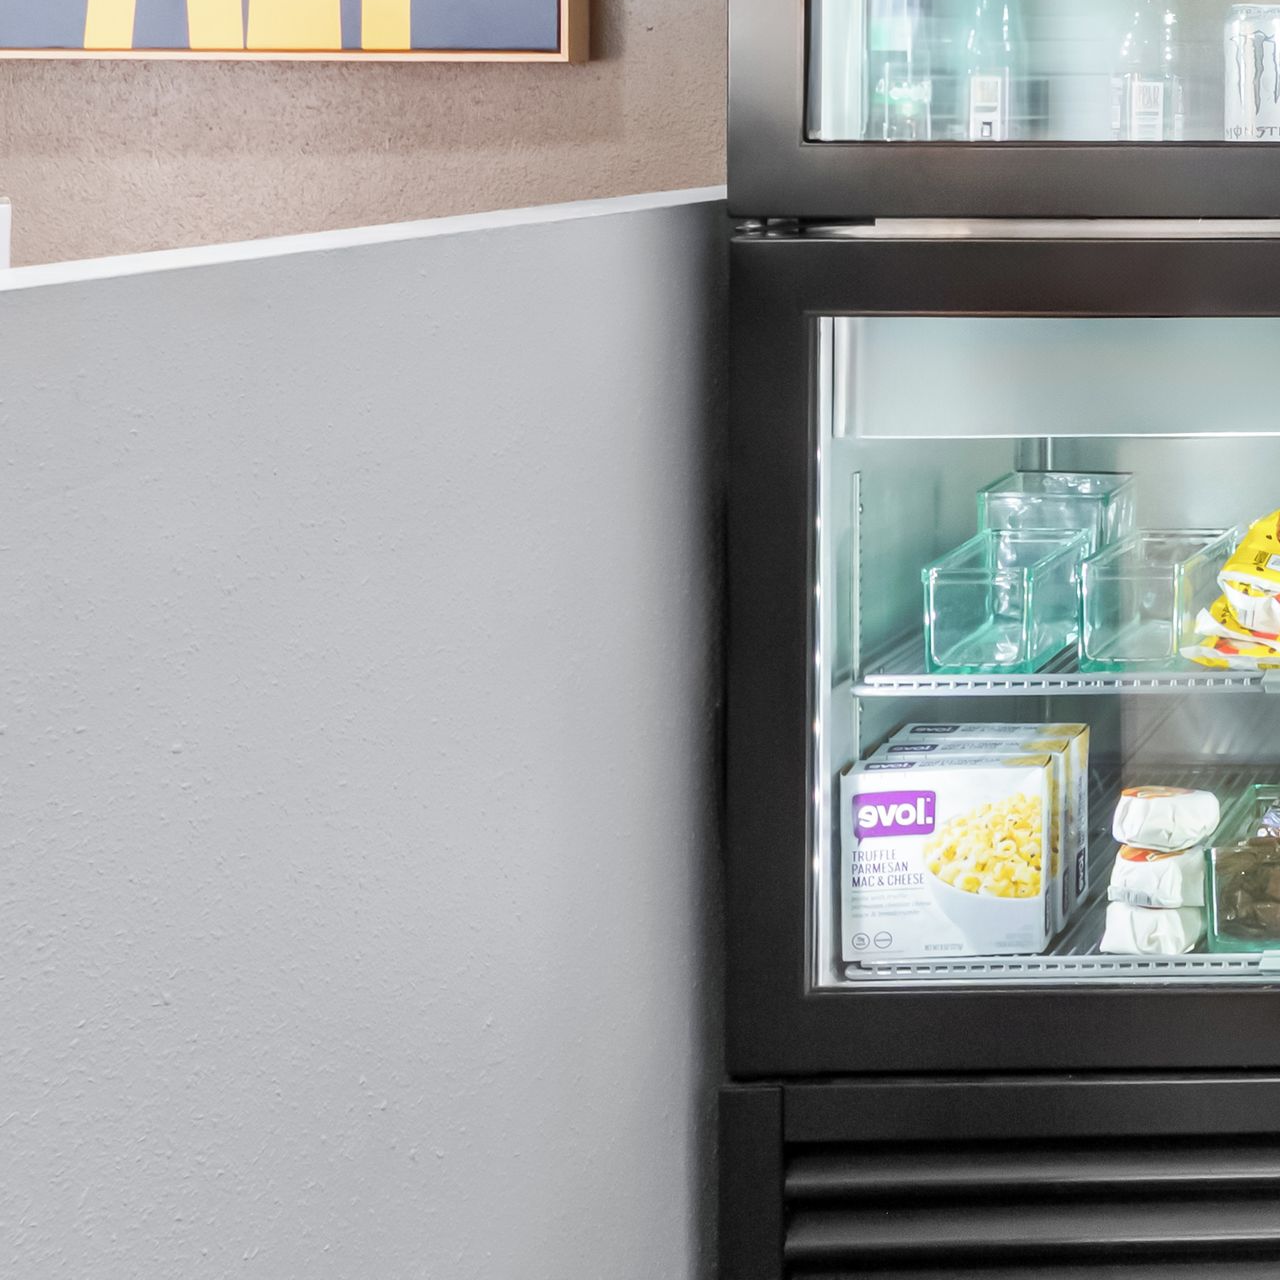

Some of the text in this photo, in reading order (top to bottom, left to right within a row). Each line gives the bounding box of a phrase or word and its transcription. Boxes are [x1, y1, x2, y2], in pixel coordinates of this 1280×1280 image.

[852, 850, 896, 862] TRUFFLE
[852, 862, 908, 874] PARMESAN
[852, 874, 924, 887] MAC & CHEESE
